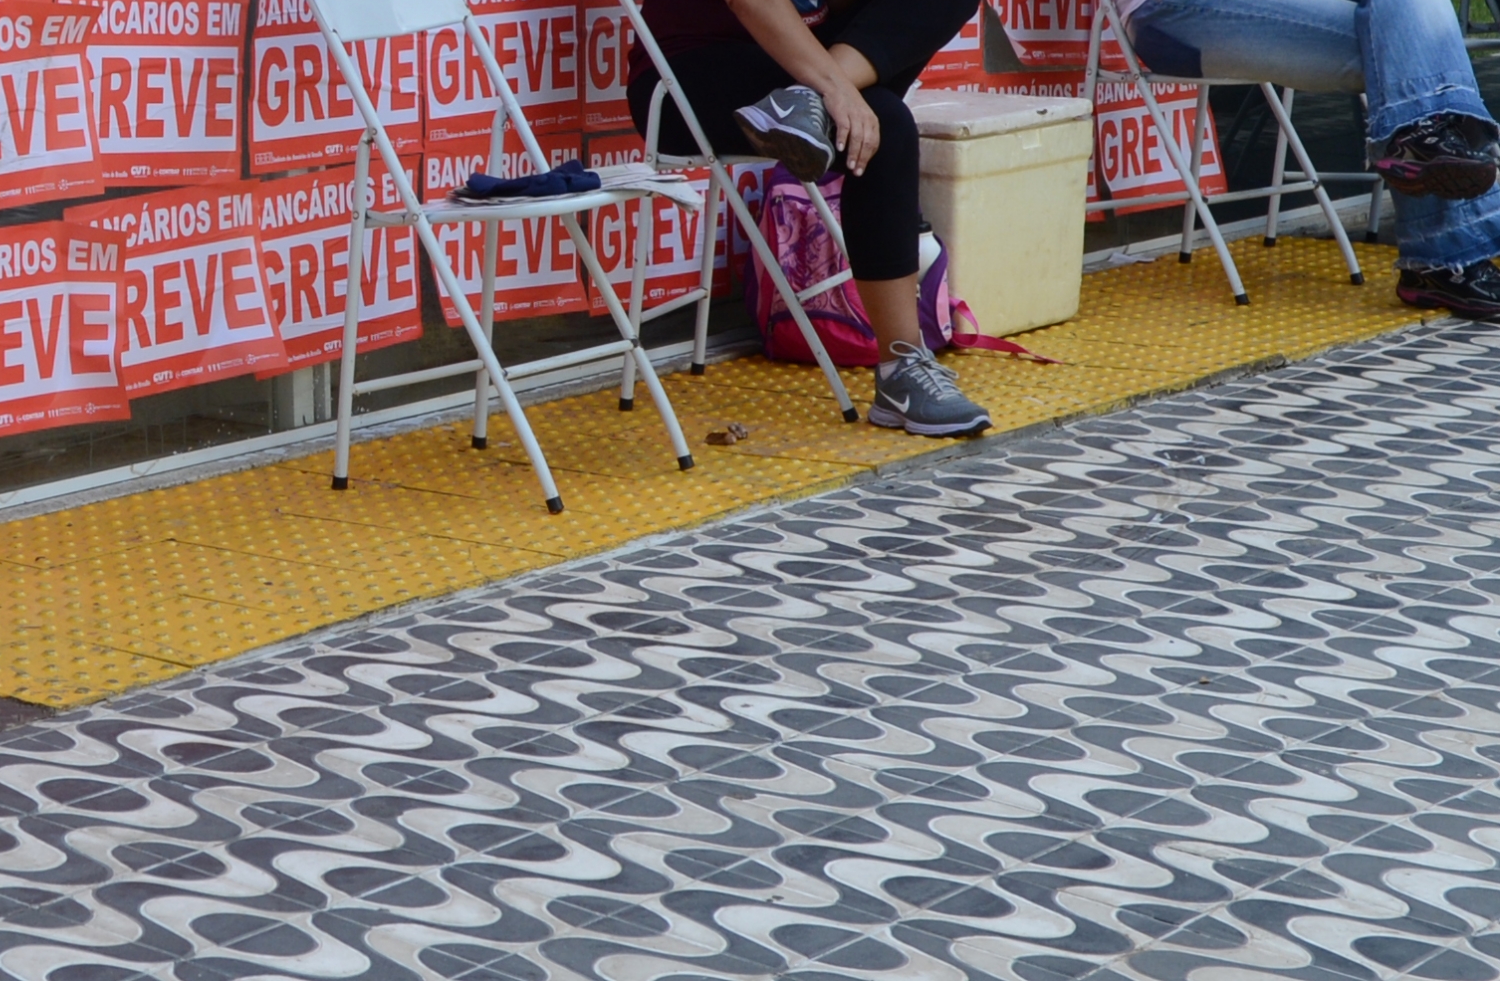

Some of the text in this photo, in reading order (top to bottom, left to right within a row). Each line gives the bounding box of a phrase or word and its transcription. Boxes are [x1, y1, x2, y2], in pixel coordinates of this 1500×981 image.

[41, 15, 91, 46] EM
[208, 1, 240, 36] EM
[100, 57, 236, 138] REVE
[216, 194, 253, 228] EM
[67, 239, 119, 272] EM
[121, 248, 268, 349] REVE
